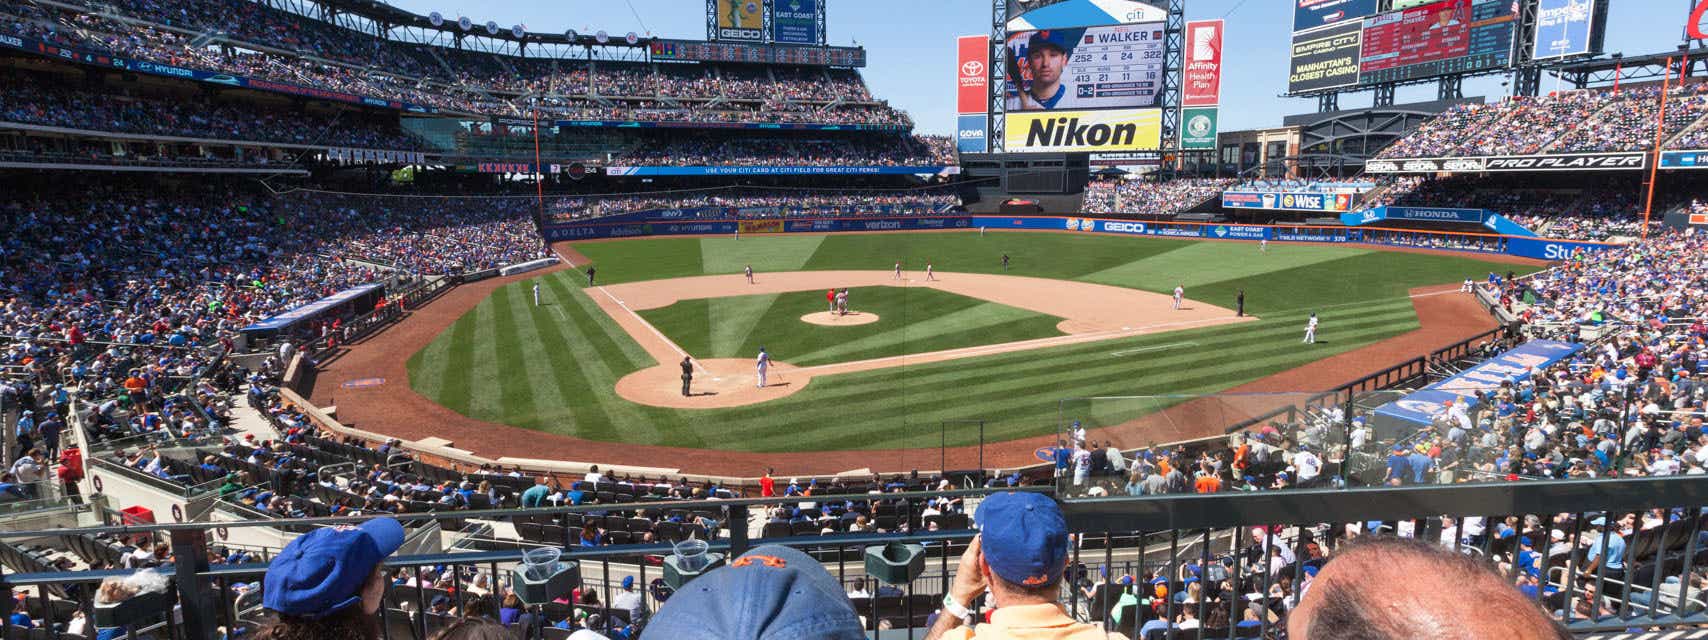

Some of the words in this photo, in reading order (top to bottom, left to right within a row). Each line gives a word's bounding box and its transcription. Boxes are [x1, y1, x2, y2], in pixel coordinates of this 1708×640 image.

[721, 29, 760, 39] GEICO
[1098, 31, 1148, 43] WALKER
[1295, 41, 1331, 53] EMPIRE
[1121, 52, 1133, 60] 24
[1188, 62, 1218, 71] Affinity
[1296, 56, 1352, 73] MANHATTAN'S
[154, 65, 193, 77] HYUNDAI
[1189, 72, 1215, 80] Health
[1290, 71, 1325, 83] CLOSEST
[1326, 65, 1358, 77] CASINO
[1193, 81, 1210, 89] Plan
[1079, 86, 1094, 95] 0-2
[960, 129, 984, 137] GOYA
[1026, 117, 1137, 147] Nikon
[1486, 158, 1536, 168] PRO
[1536, 156, 1643, 168] PLAYER
[1295, 195, 1321, 209] WISE
[1414, 211, 1459, 219] HONDA
[865, 220, 900, 230] verizon
[1104, 221, 1144, 233] GEICO
[561, 228, 595, 237] DELTA
